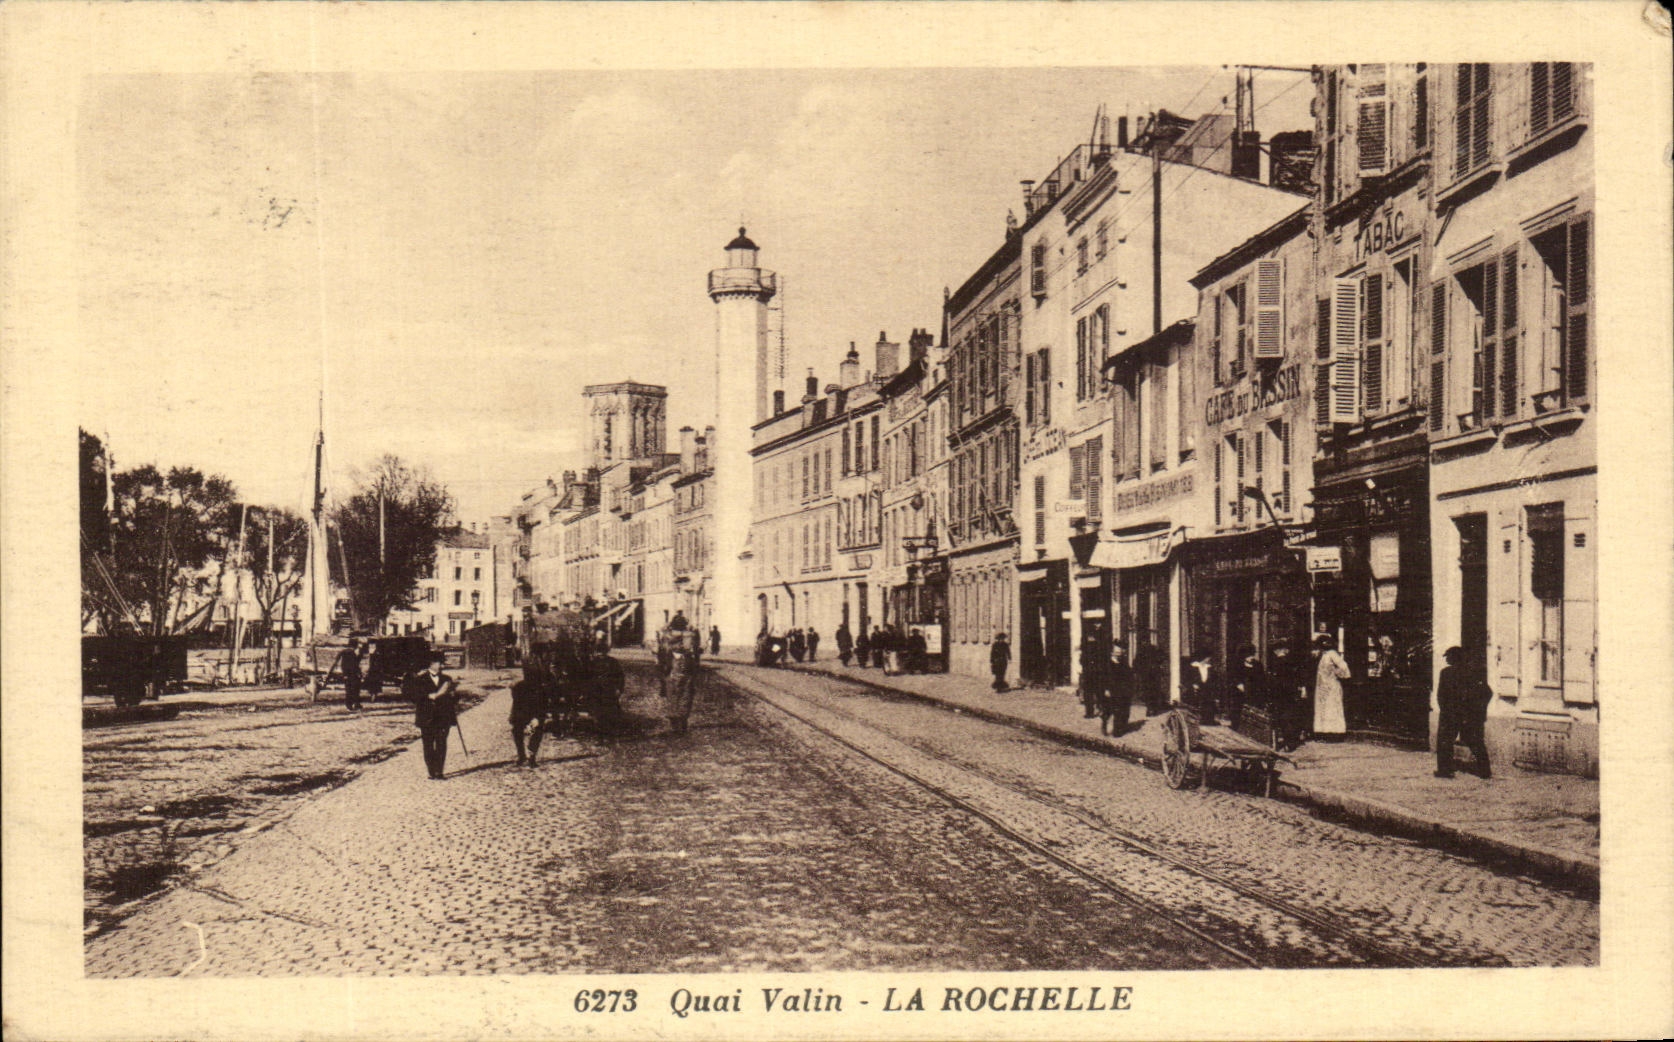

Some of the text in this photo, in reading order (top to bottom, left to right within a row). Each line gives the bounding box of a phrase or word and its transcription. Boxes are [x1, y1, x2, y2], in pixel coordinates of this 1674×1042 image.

[1354, 211, 1404, 262] TABAC
[1237, 394, 1249, 416] DU
[1252, 365, 1301, 410] BASSIN
